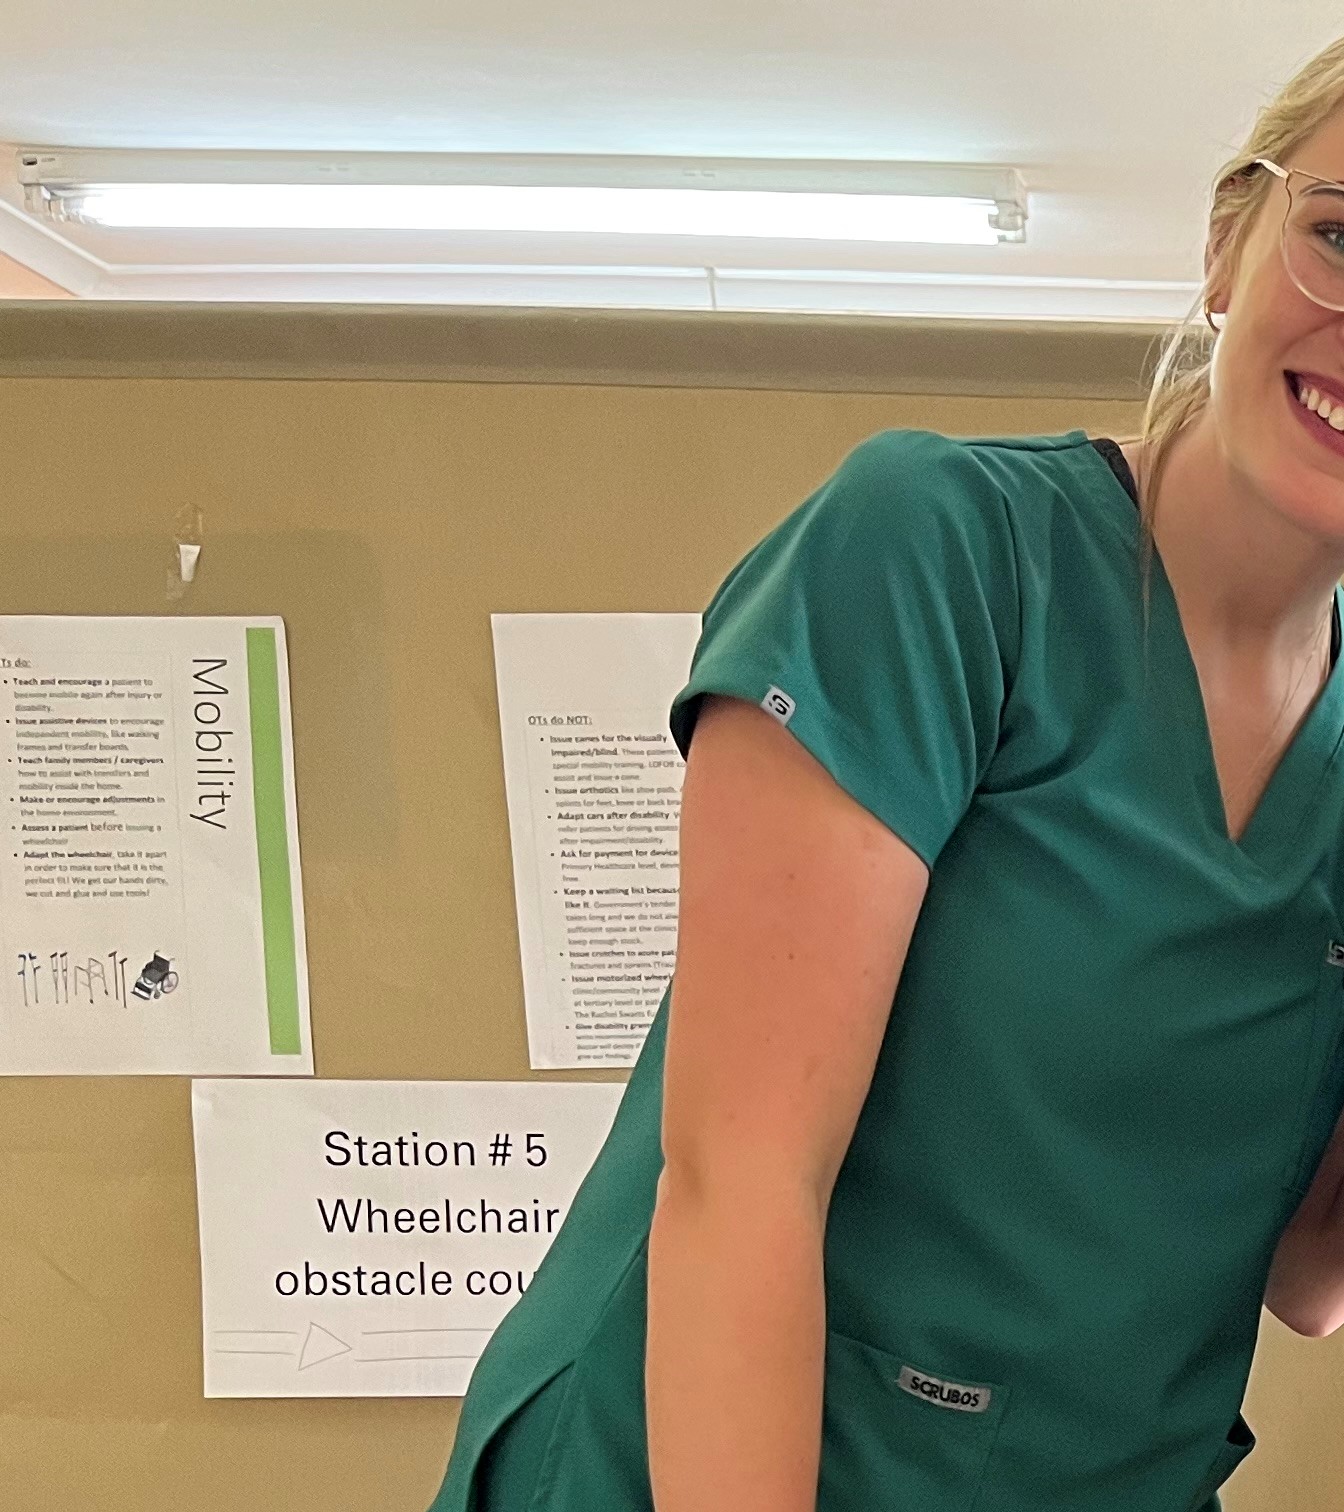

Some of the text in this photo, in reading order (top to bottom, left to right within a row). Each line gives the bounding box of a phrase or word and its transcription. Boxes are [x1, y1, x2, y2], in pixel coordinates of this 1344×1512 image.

[190, 658, 236, 829] Mobility
[324, 1130, 548, 1167] Station # 5
[317, 1197, 561, 1234] Wheelchair
[274, 1262, 453, 1297] obstacle
